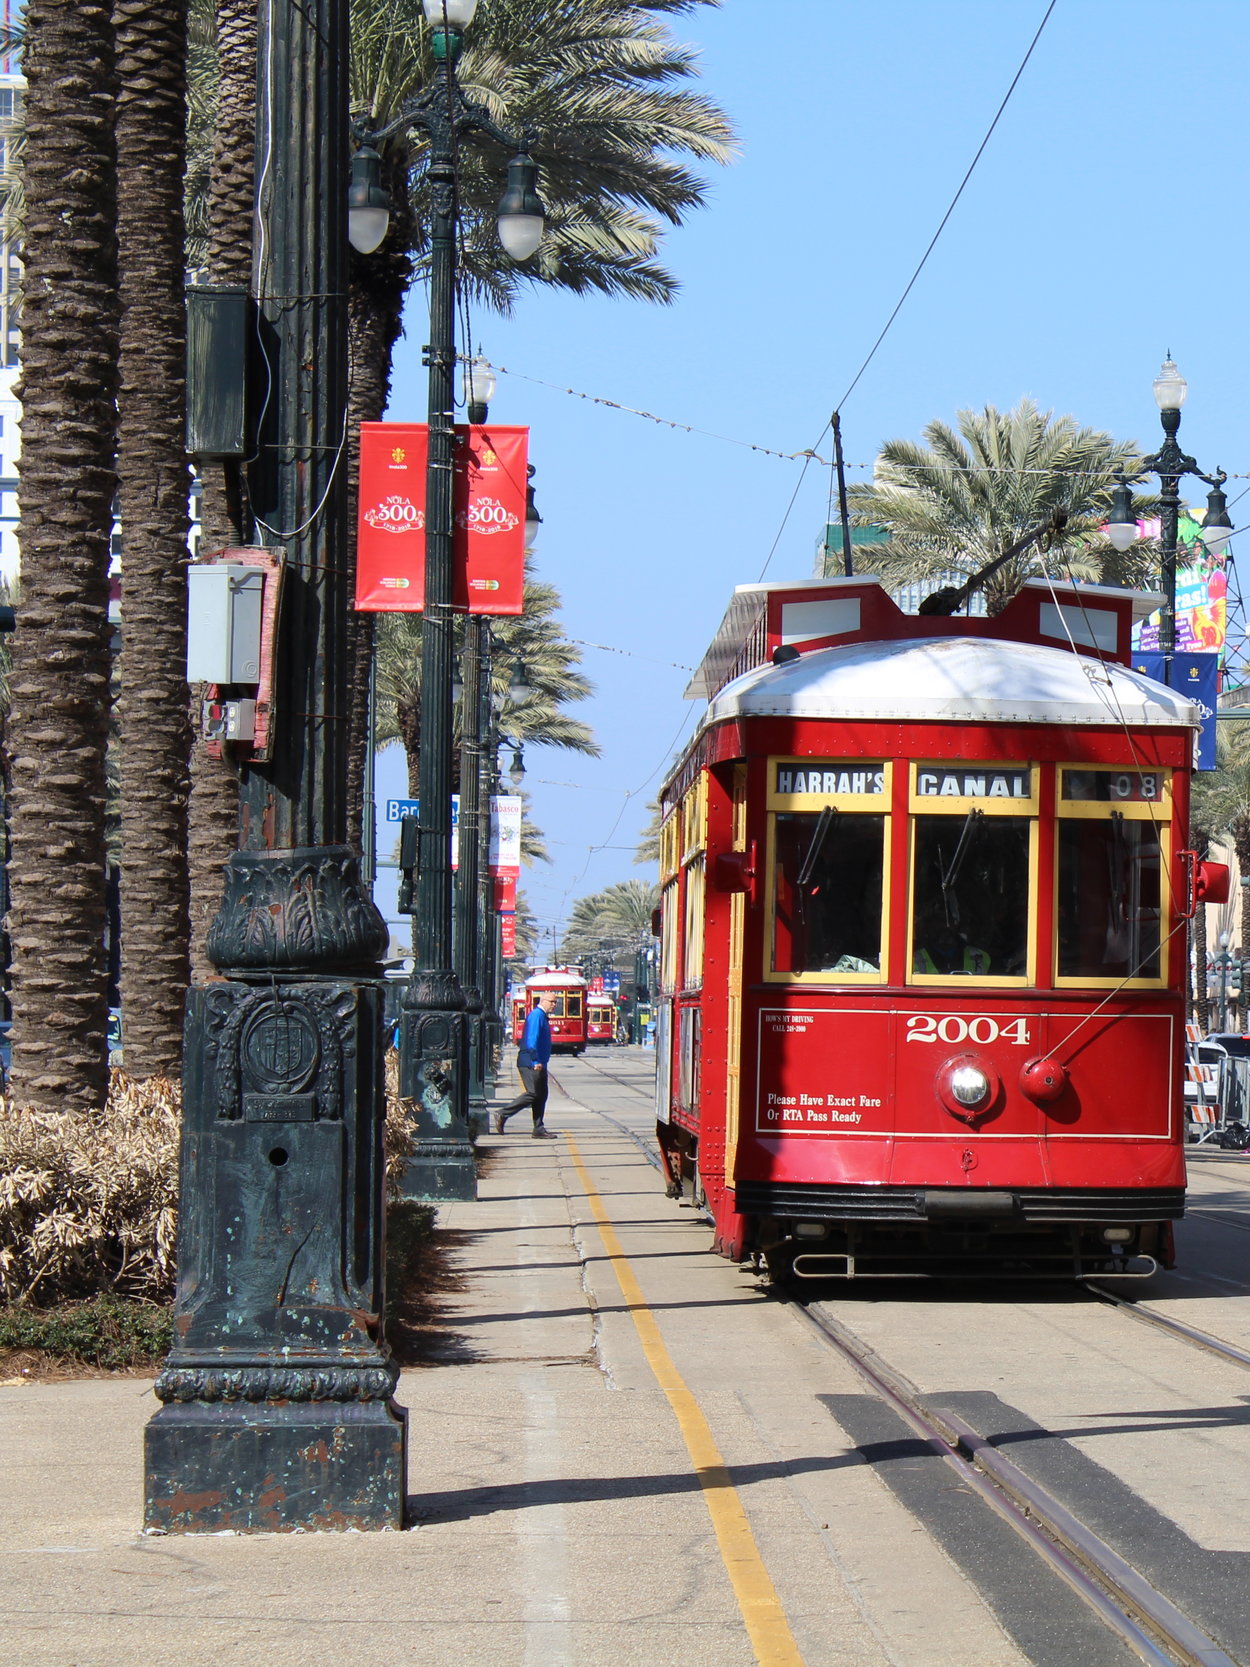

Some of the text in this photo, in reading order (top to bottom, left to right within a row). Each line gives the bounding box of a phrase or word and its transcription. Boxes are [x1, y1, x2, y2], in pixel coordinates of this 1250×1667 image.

[386, 495, 411, 505] NOLA
[476, 497, 501, 506] NOLA
[378, 503, 417, 522] 300
[468, 505, 507, 523] 300
[1175, 585, 1208, 610] ras!
[778, 770, 885, 795] HARRAH'S
[918, 773, 1030, 798] CANAL
[491, 802, 519, 813] Tabasco
[783, 1015, 790, 1023] MY
[791, 1015, 814, 1023] DRIVING
[906, 1015, 1030, 1045] 2004
[767, 1093, 881, 1107] Please Have Exact Fare
[767, 1108, 862, 1124] Or RTA Pass Ready
